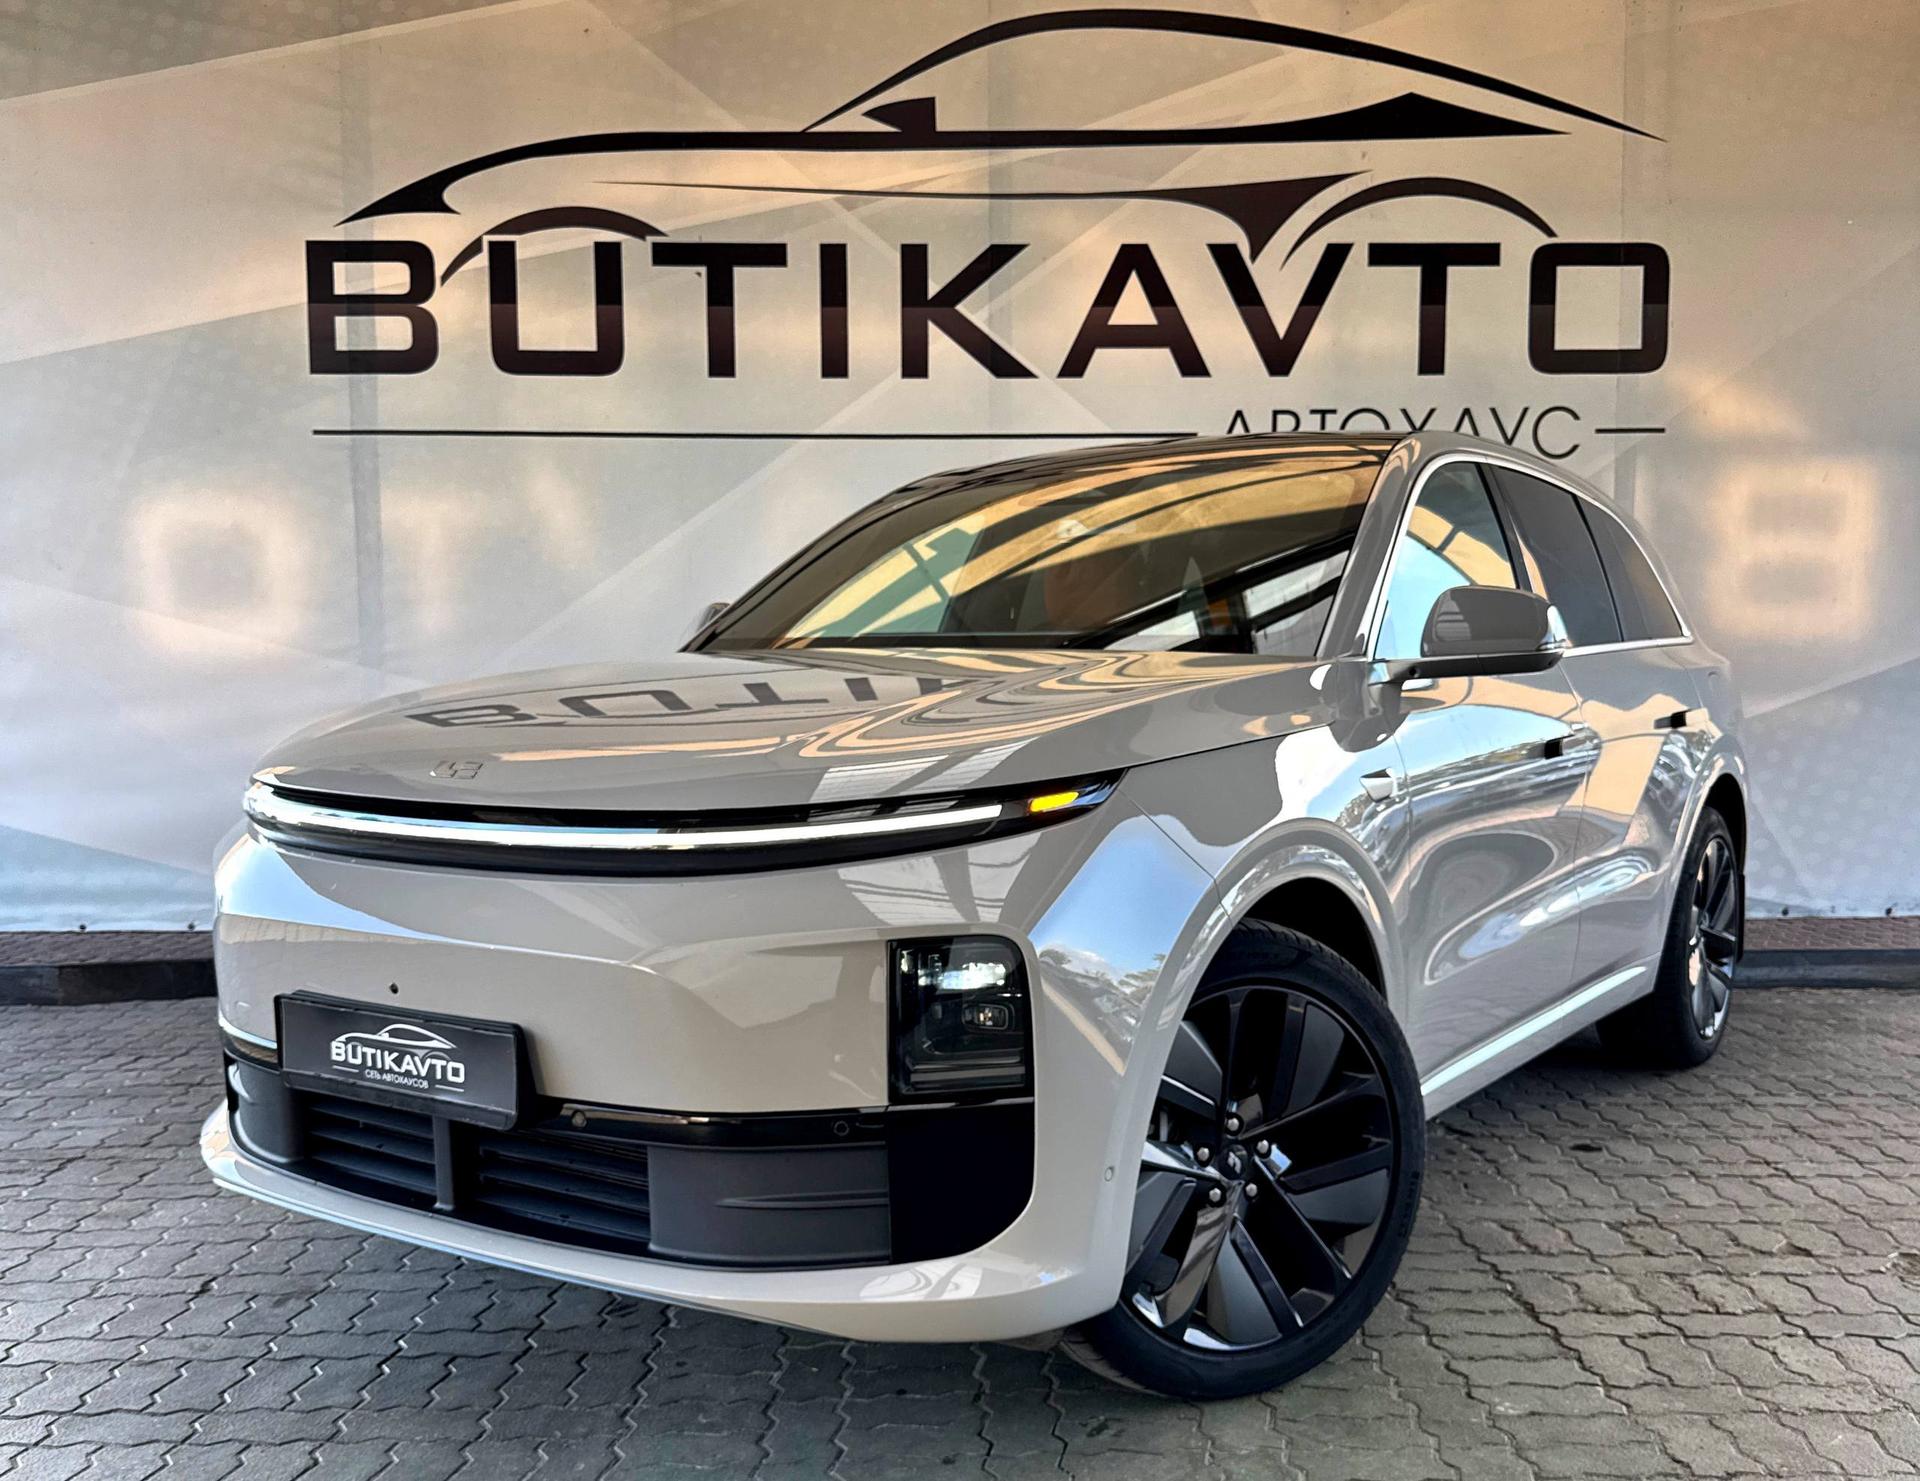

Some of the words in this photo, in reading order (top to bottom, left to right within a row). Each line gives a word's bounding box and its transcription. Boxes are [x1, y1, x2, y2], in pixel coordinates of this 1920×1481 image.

[305, 240, 1670, 378] BUTIKAVTO
[331, 1040, 465, 1083] BUTIKAVTO
[382, 1073, 429, 1089] АВТОХАУСОВ
